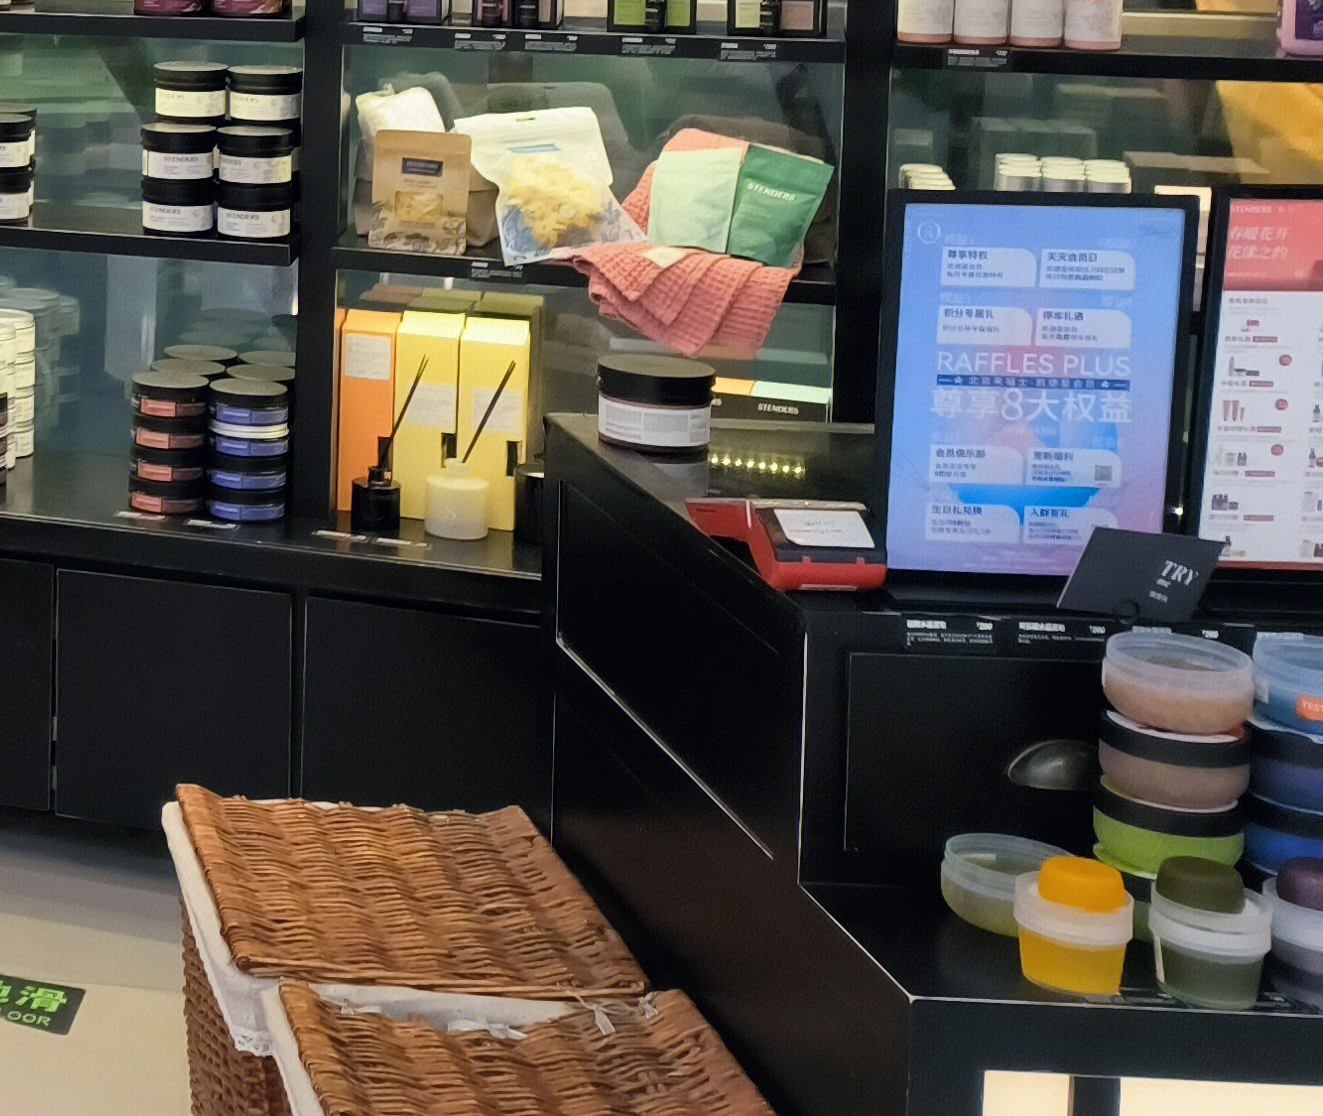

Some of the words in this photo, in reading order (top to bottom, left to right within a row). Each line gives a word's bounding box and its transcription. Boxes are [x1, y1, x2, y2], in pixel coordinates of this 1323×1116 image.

[747, 182, 796, 202] STENDERS
[938, 351, 1054, 374] RAFFLES
[1063, 354, 1131, 376] PLUS
[758, 402, 798, 414] STENDERS
[1161, 559, 1200, 586] TRY
